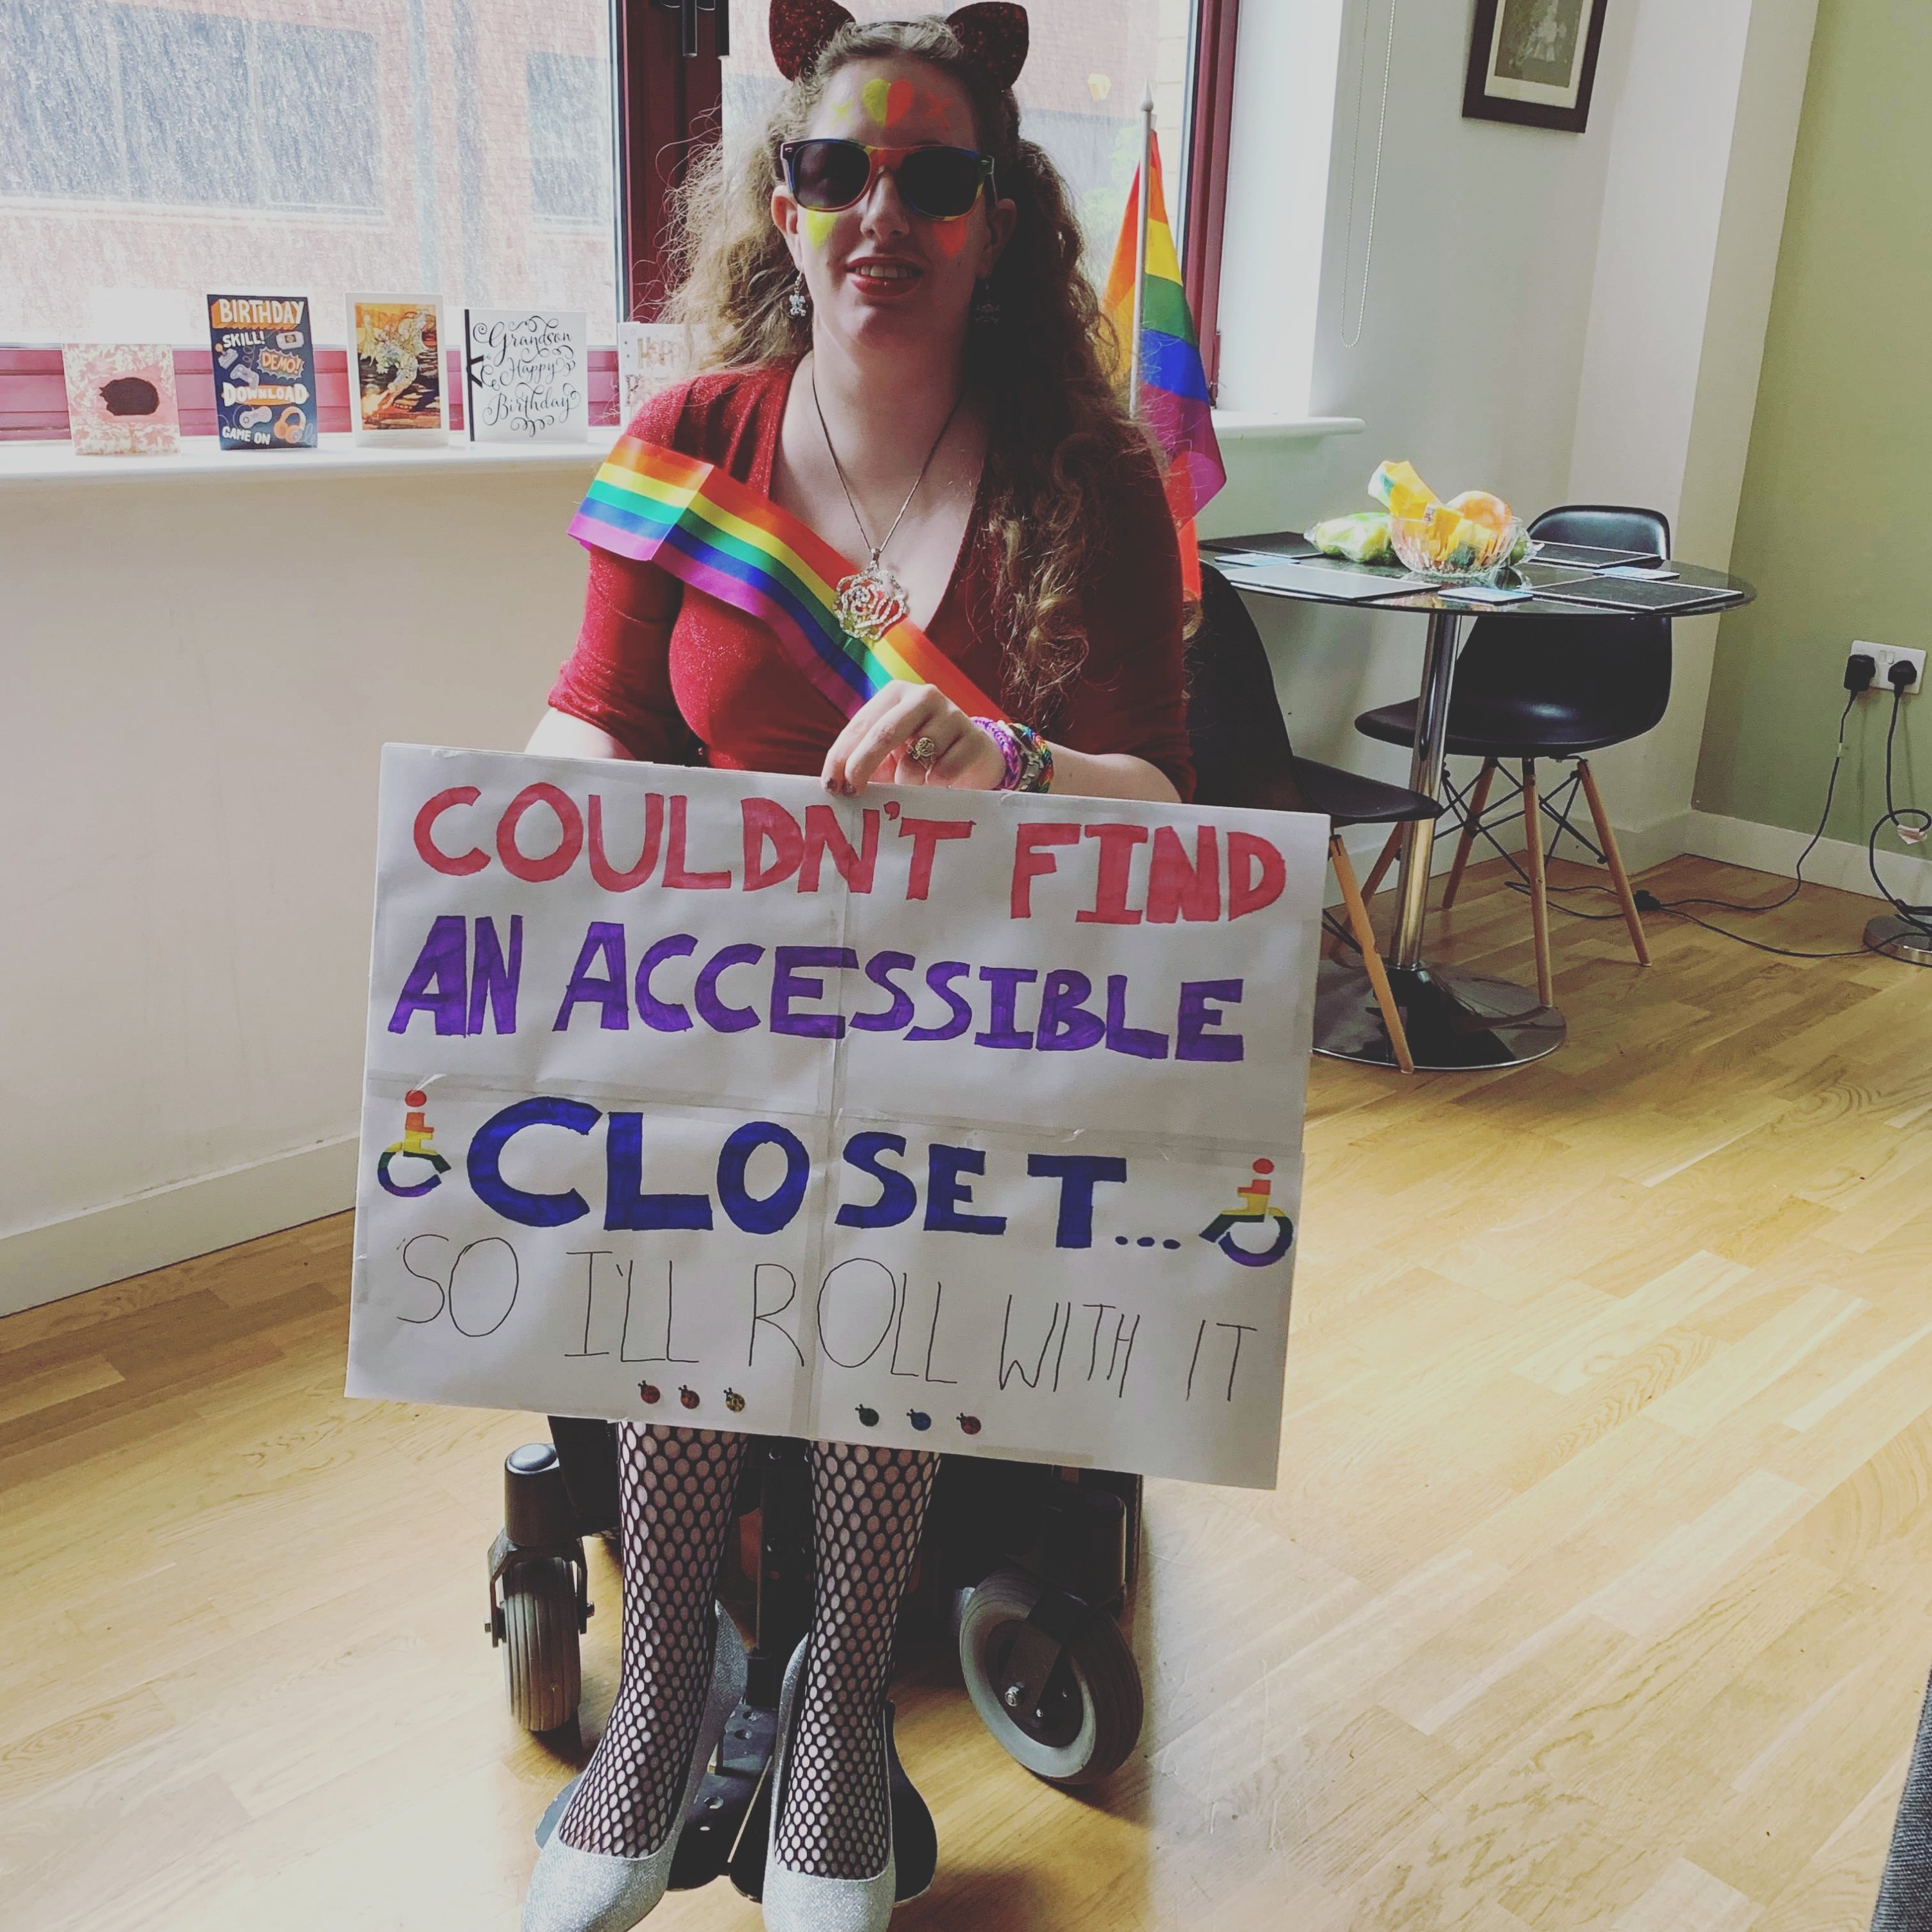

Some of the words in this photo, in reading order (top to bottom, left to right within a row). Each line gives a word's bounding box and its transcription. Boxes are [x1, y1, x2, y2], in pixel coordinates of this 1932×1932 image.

[219, 298, 305, 325] BIRTHDAY
[222, 330, 265, 349] SKILL!
[473, 316, 573, 366] Grandson
[261, 352, 300, 374] DEMO!
[500, 357, 565, 386] Happy
[222, 382, 307, 406] DOWNLOAD
[483, 382, 581, 426] Birthday
[222, 426, 252, 442] GAME
[253, 433, 271, 446] ON
[413, 782, 977, 901] COULDN'T
[1010, 822, 1286, 925] FIND
[387, 914, 524, 1038] AN
[552, 921, 1244, 1062] ACCESSIBLE
[467, 1095, 1181, 1249] CLOSET...
[397, 1234, 519, 1338] SO
[564, 1251, 700, 1363] I'LL
[748, 1257, 958, 1385] ROLL
[999, 1294, 1141, 1398] WITH
[1186, 1320, 1258, 1402] IT
